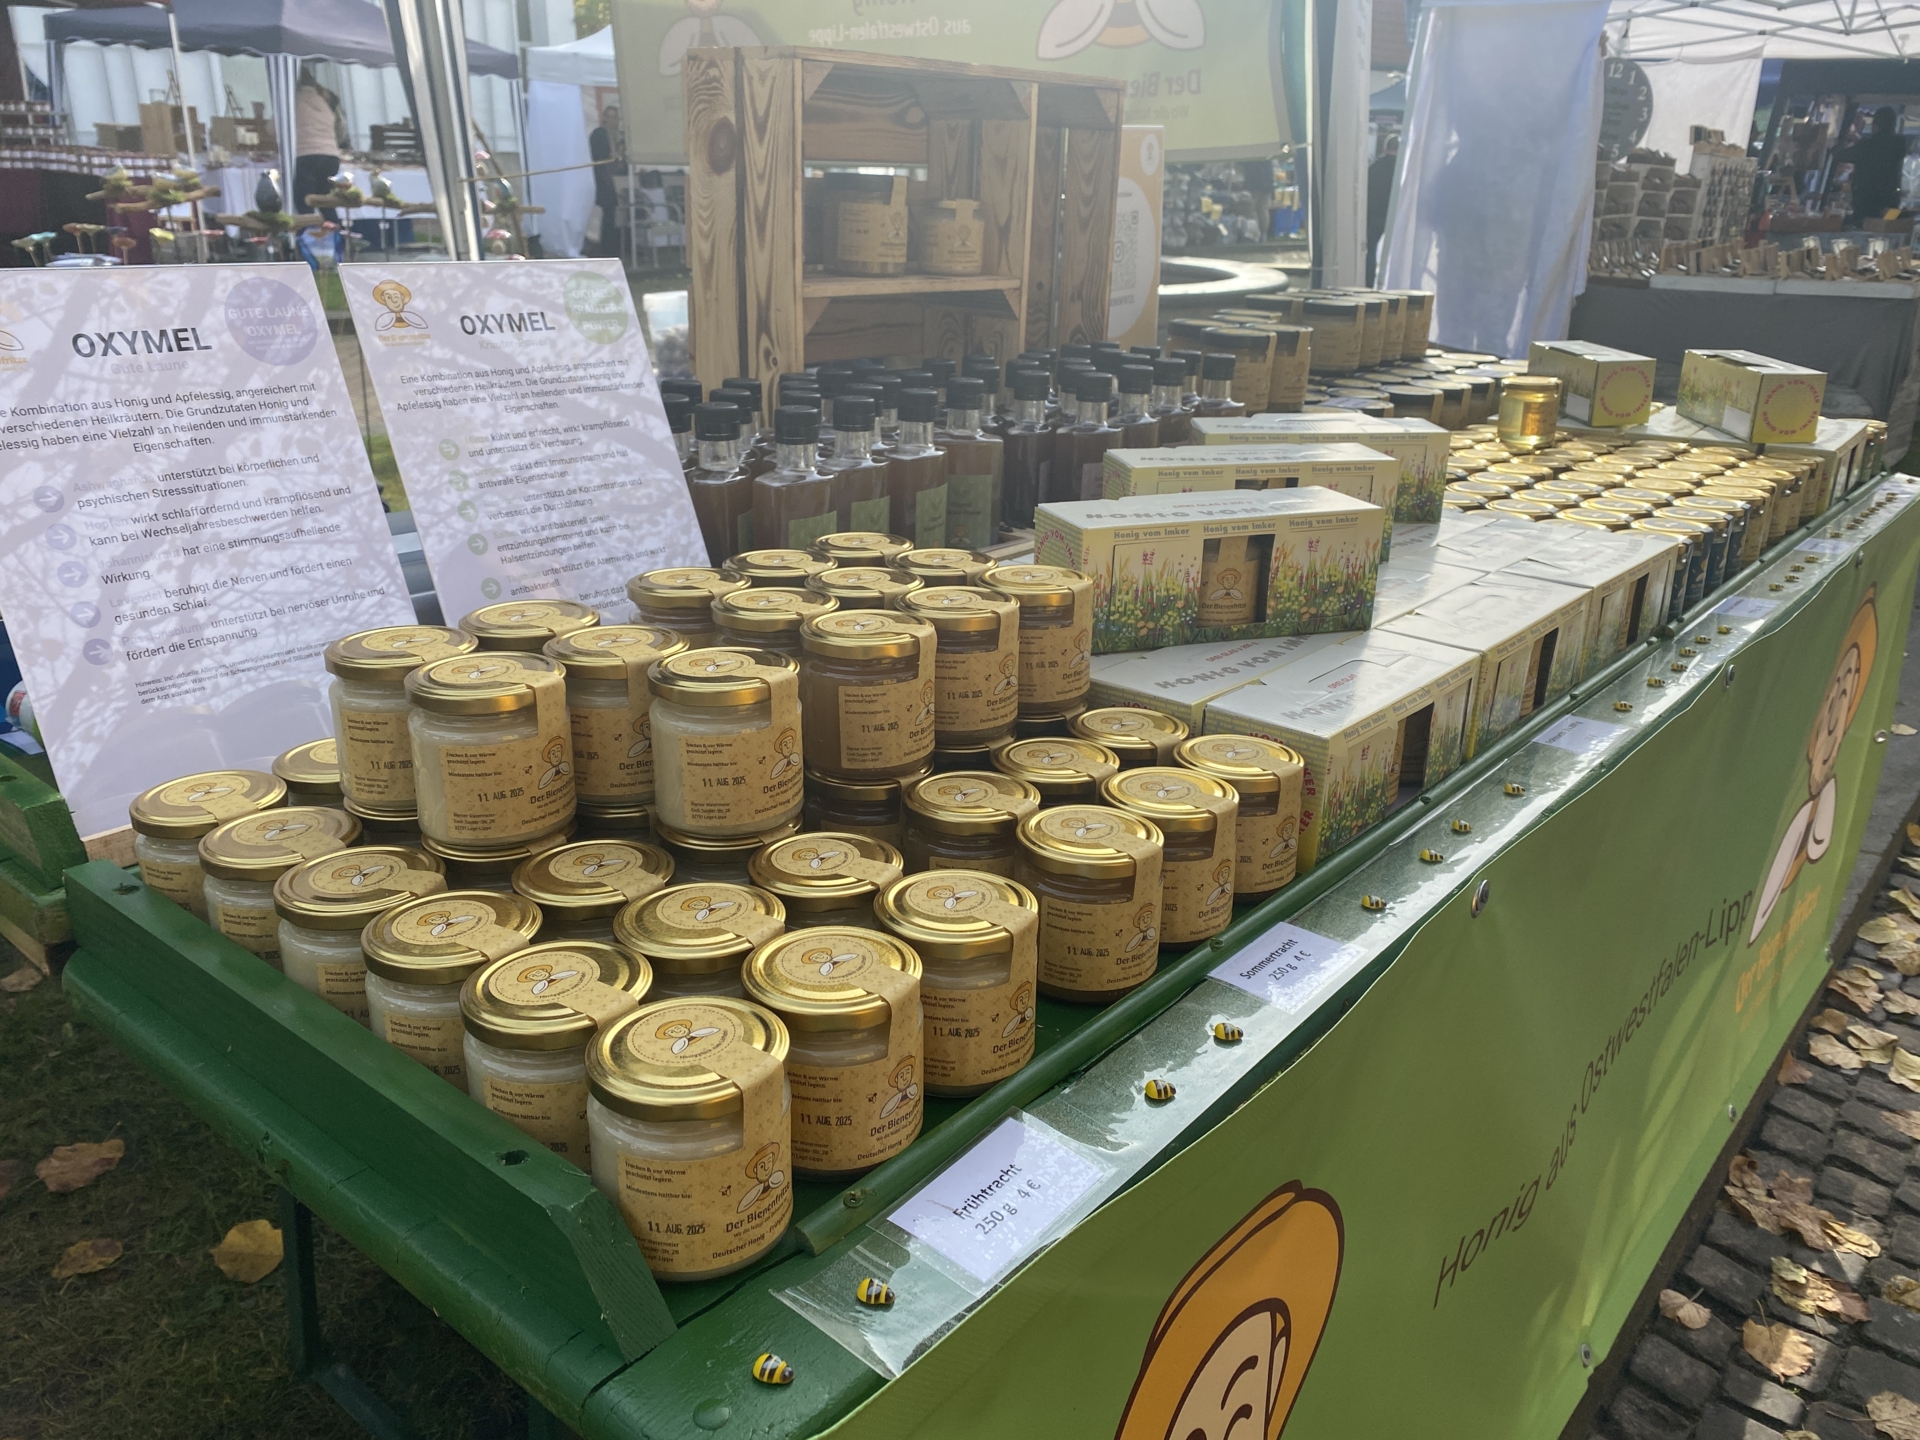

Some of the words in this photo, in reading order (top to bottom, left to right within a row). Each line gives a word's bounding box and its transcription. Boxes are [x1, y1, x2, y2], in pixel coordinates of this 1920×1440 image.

[1609, 63, 1623, 78] 12
[1629, 70, 1636, 85] 1
[1638, 86, 1647, 100] 2
[1639, 107, 1648, 121] 3
[228, 307, 263, 319] GUTE
[265, 305, 309, 318] LAUNE
[247, 324, 301, 337] OXYMEL
[460, 311, 556, 336] OXYMEL
[582, 319, 620, 331] POWER
[72, 327, 212, 358] OXYMEL
[420, 370, 473, 383] Kombination
[414, 384, 473, 396] verschiedenen
[1764, 382, 1785, 405] HONIG
[10, 402, 88, 418] Kombination
[91, 400, 113, 410] aus
[114, 395, 149, 408] Honig
[151, 394, 172, 405] und
[175, 389, 234, 404] Apfelessig,
[236, 384, 298, 399] angereichert
[300, 382, 317, 392] mit
[397, 399, 442, 412] Apfelessig
[443, 396, 468, 407] haben
[1, 417, 88, 434] verschiedenen
[91, 411, 164, 426] Heilkräutern.
[187, 402, 257, 417] Grundzutaten
[259, 398, 288, 411] Honig
[291, 397, 309, 407] und
[1762, 411, 1777, 433] HONIG
[41, 434, 79, 447] haben
[83, 431, 107, 442] eine
[109, 425, 154, 440] Vielzahl
[173, 419, 225, 434] heilenden
[228, 416, 247, 427] und
[250, 409, 337, 425] immunstärkenden
[133, 436, 215, 453] Eigenschaften.
[158, 466, 216, 482] unterstützt
[219, 463, 235, 475] bei
[237, 456, 299, 473] körperlichen
[301, 453, 319, 465] und
[1158, 469, 1180, 478] Honig
[1202, 468, 1224, 476] Imker
[1235, 467, 1258, 476] Honig
[1278, 466, 1300, 474] Imker
[77, 490, 149, 510] psychischen
[152, 478, 248, 498] Stresssituationen.
[131, 512, 158, 525] wirkt
[162, 501, 240, 521] schlaffördernd
[243, 497, 261, 508] und
[264, 487, 331, 507] krampflösend
[333, 485, 351, 496] und
[89, 534, 118, 547] kann
[121, 530, 139, 542] bei
[141, 508, 288, 539] Wechseljahresbeschwerden
[290, 505, 324, 517] helfen.
[1203, 524, 1228, 534] Honig
[1231, 523, 1249, 531] vom
[1252, 521, 1276, 530] Imker
[1289, 518, 1313, 528] Honig
[1316, 517, 1333, 525] vom
[1336, 515, 1359, 524] Imker
[182, 544, 201, 556] hat
[203, 541, 225, 553] eine
[227, 523, 341, 550] stimmungsaufhellende
[1050, 528, 1065, 544] VOM
[1114, 531, 1139, 540] Honig
[1143, 529, 1161, 537] vom
[1164, 528, 1190, 536] Imker
[101, 569, 154, 585] Wirkung.
[164, 582, 210, 598] beruhigt
[212, 579, 229, 590] die
[230, 571, 267, 587] Nerven
[270, 567, 289, 580] und
[290, 561, 324, 575] fördert
[326, 558, 352, 570] einen
[114, 605, 171, 625] gesunden
[172, 596, 211, 612] Schlaf.
[211, 610, 267, 628] unterstützt
[269, 605, 286, 617] bei
[288, 596, 330, 614] nervöser
[331, 590, 366, 605] Unruhe
[367, 585, 385, 597] und
[126, 643, 167, 661] fördert
[168, 640, 186, 652] die
[187, 626, 261, 649] Entspannung.
[1343, 728, 1359, 740] Honig
[619, 762, 634, 770] Der
[610, 779, 637, 788] Deutscher
[702, 778, 713, 787] 11
[732, 776, 746, 786] 2025
[477, 793, 489, 802] 11
[509, 787, 525, 798] 2025
[763, 784, 776, 794] Der
[530, 794, 545, 804] Der
[755, 803, 778, 815] Deutscher
[521, 813, 547, 825] Deutscher
[1164, 903, 1178, 912] 2025
[1198, 908, 1210, 918] Der
[1096, 947, 1110, 957] 2025
[1116, 957, 1130, 965] Der
[1240, 939, 1298, 980] Sommertracht
[1268, 966, 1289, 981] 250
[1286, 963, 1298, 971] g
[1106, 975, 1131, 984] Deutscher
[933, 1026, 944, 1037] 11
[965, 1028, 980, 1038] 2025
[992, 1042, 1007, 1054] Der
[444, 1064, 461, 1076] 2025
[981, 1063, 1007, 1076] Deutscher
[1432, 1173, 1542, 1311] Honig
[1545, 1103, 1577, 1190] aus
[1581, 890, 1754, 1115] Ostwestfalen-Lipp
[800, 1113, 812, 1125] 11
[835, 1116, 853, 1127] 2025
[870, 1124, 886, 1137] Der
[857, 1147, 887, 1160] Deutscher
[888, 1139, 902, 1152] Honig
[664, 1167, 686, 1175] Wärme
[652, 1175, 674, 1184] lagern.
[626, 1184, 657, 1198] Mindestens
[952, 1163, 1023, 1220] Frühtracht
[726, 1217, 745, 1233] Der
[747, 1181, 790, 1224] Bienenfritze
[975, 1210, 1004, 1235] 250
[1003, 1202, 1018, 1216] g
[1017, 1187, 1030, 1201] 4
[1027, 1179, 1041, 1190] €
[647, 1221, 661, 1234] 11
[686, 1223, 705, 1236] 2025
[712, 1242, 747, 1259] Deutscher
[748, 1233, 765, 1247] Honig
